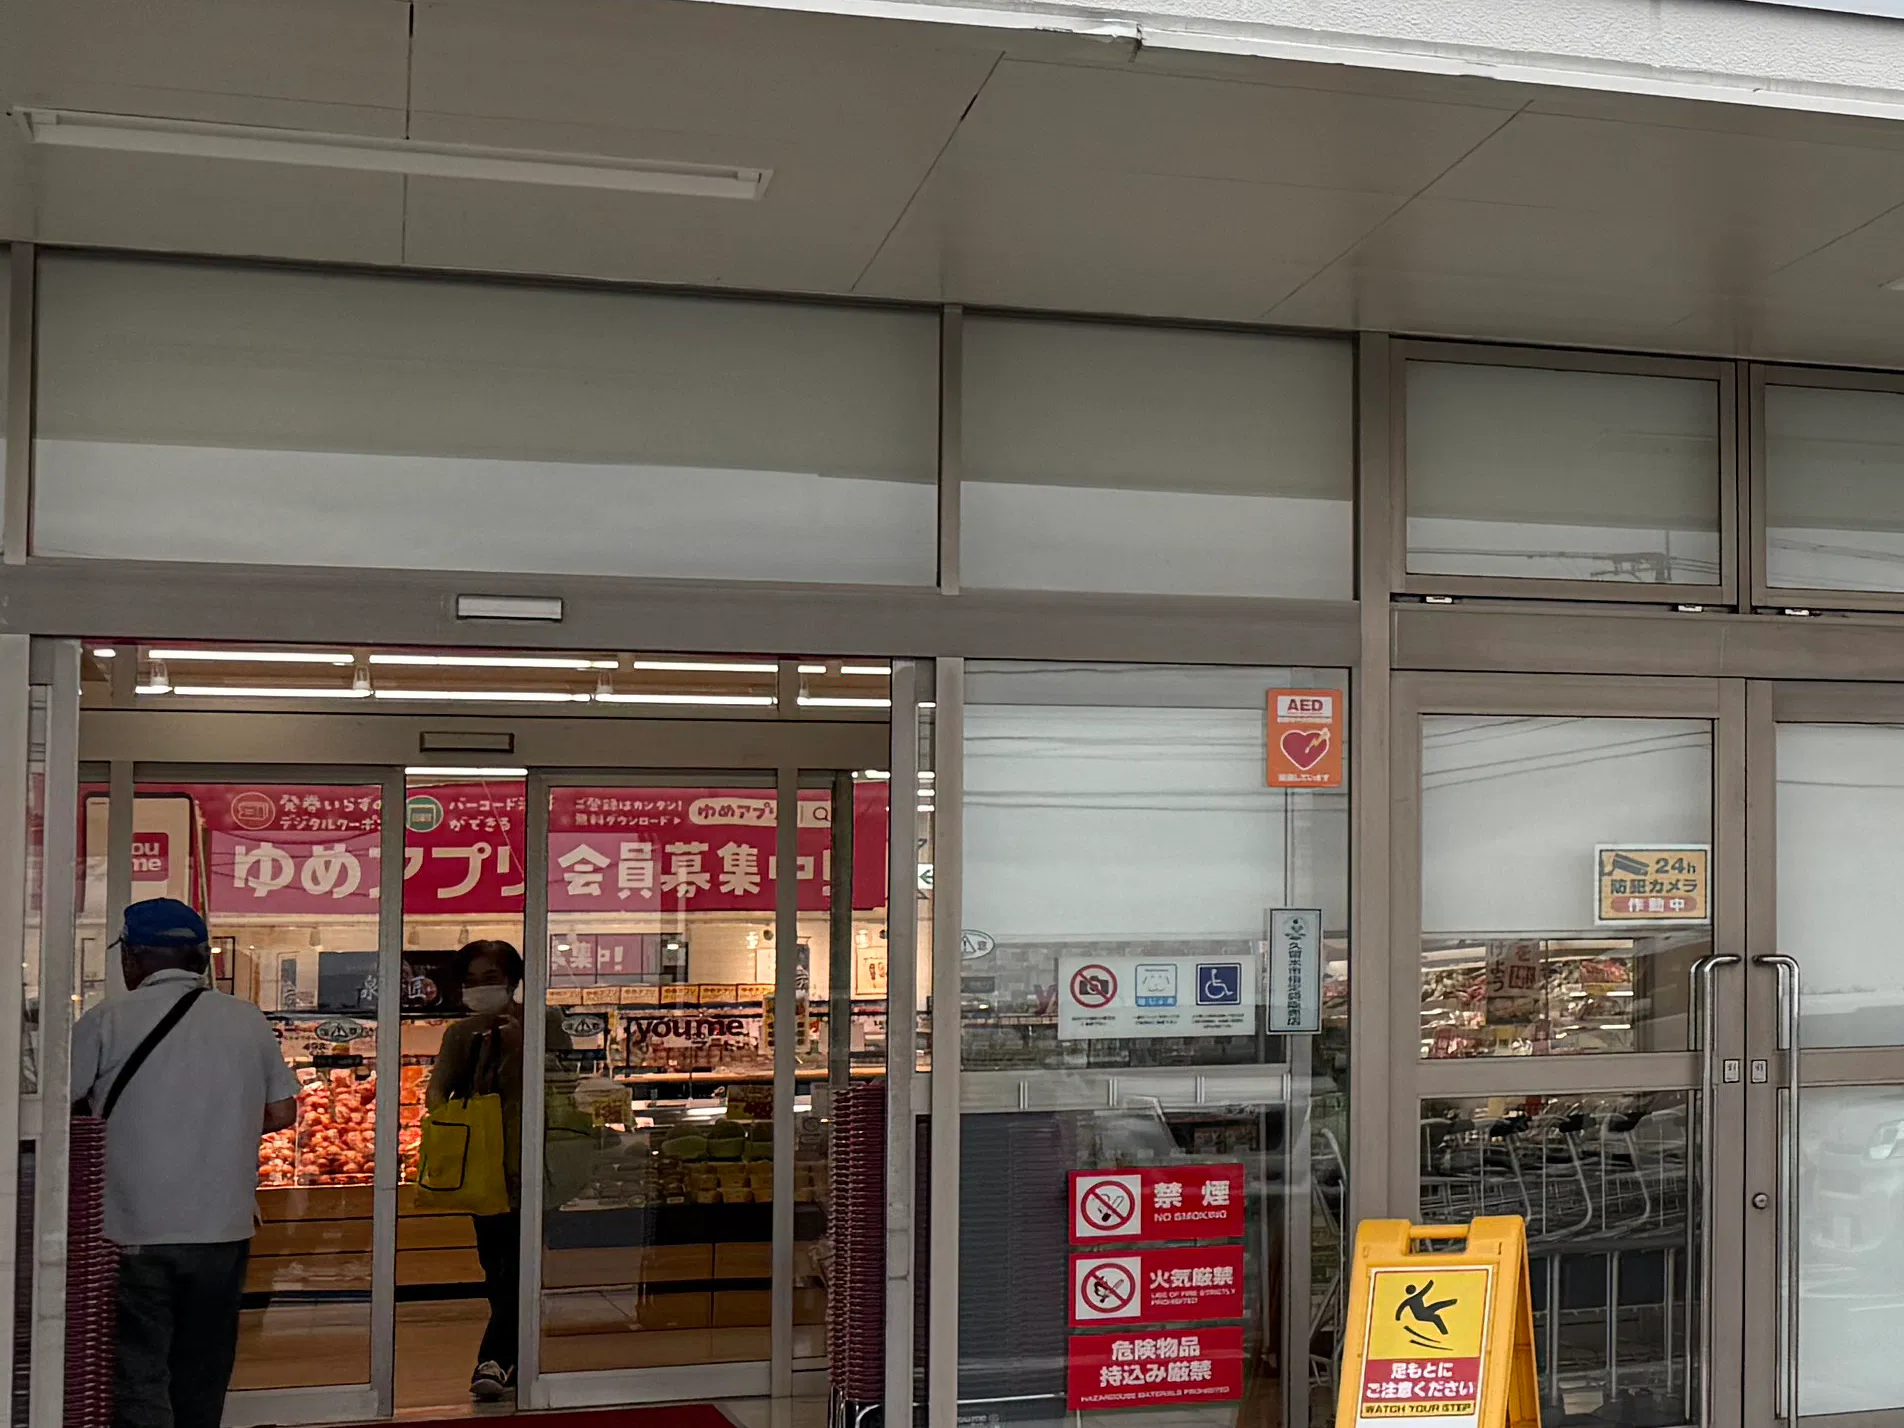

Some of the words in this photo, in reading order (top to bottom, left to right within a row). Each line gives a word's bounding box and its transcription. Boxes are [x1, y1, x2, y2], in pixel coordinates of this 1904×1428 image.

[1287, 698, 1324, 712] AED
[280, 814, 381, 831] デジタルクーポ
[449, 816, 511, 832] ができる
[132, 842, 160, 856] ou
[1654, 857, 1696, 875] 24h
[1611, 878, 1698, 895] 防犯カメラ
[1628, 897, 1685, 913] 作動中
[1154, 1213, 1172, 1223] NO
[1174, 1210, 1227, 1221] SMOKING
[1149, 1266, 1234, 1289] 火気厳禁
[1112, 1336, 1200, 1361] 危険物品
[1100, 1360, 1212, 1387] 持込み厳禁
[1391, 1361, 1454, 1379] 足もとに
[1366, 1381, 1475, 1399] ご注意ください
[1366, 1404, 1406, 1414] WATCH
[1408, 1403, 1440, 1413] YOUR
[1441, 1402, 1472, 1412] STEP
